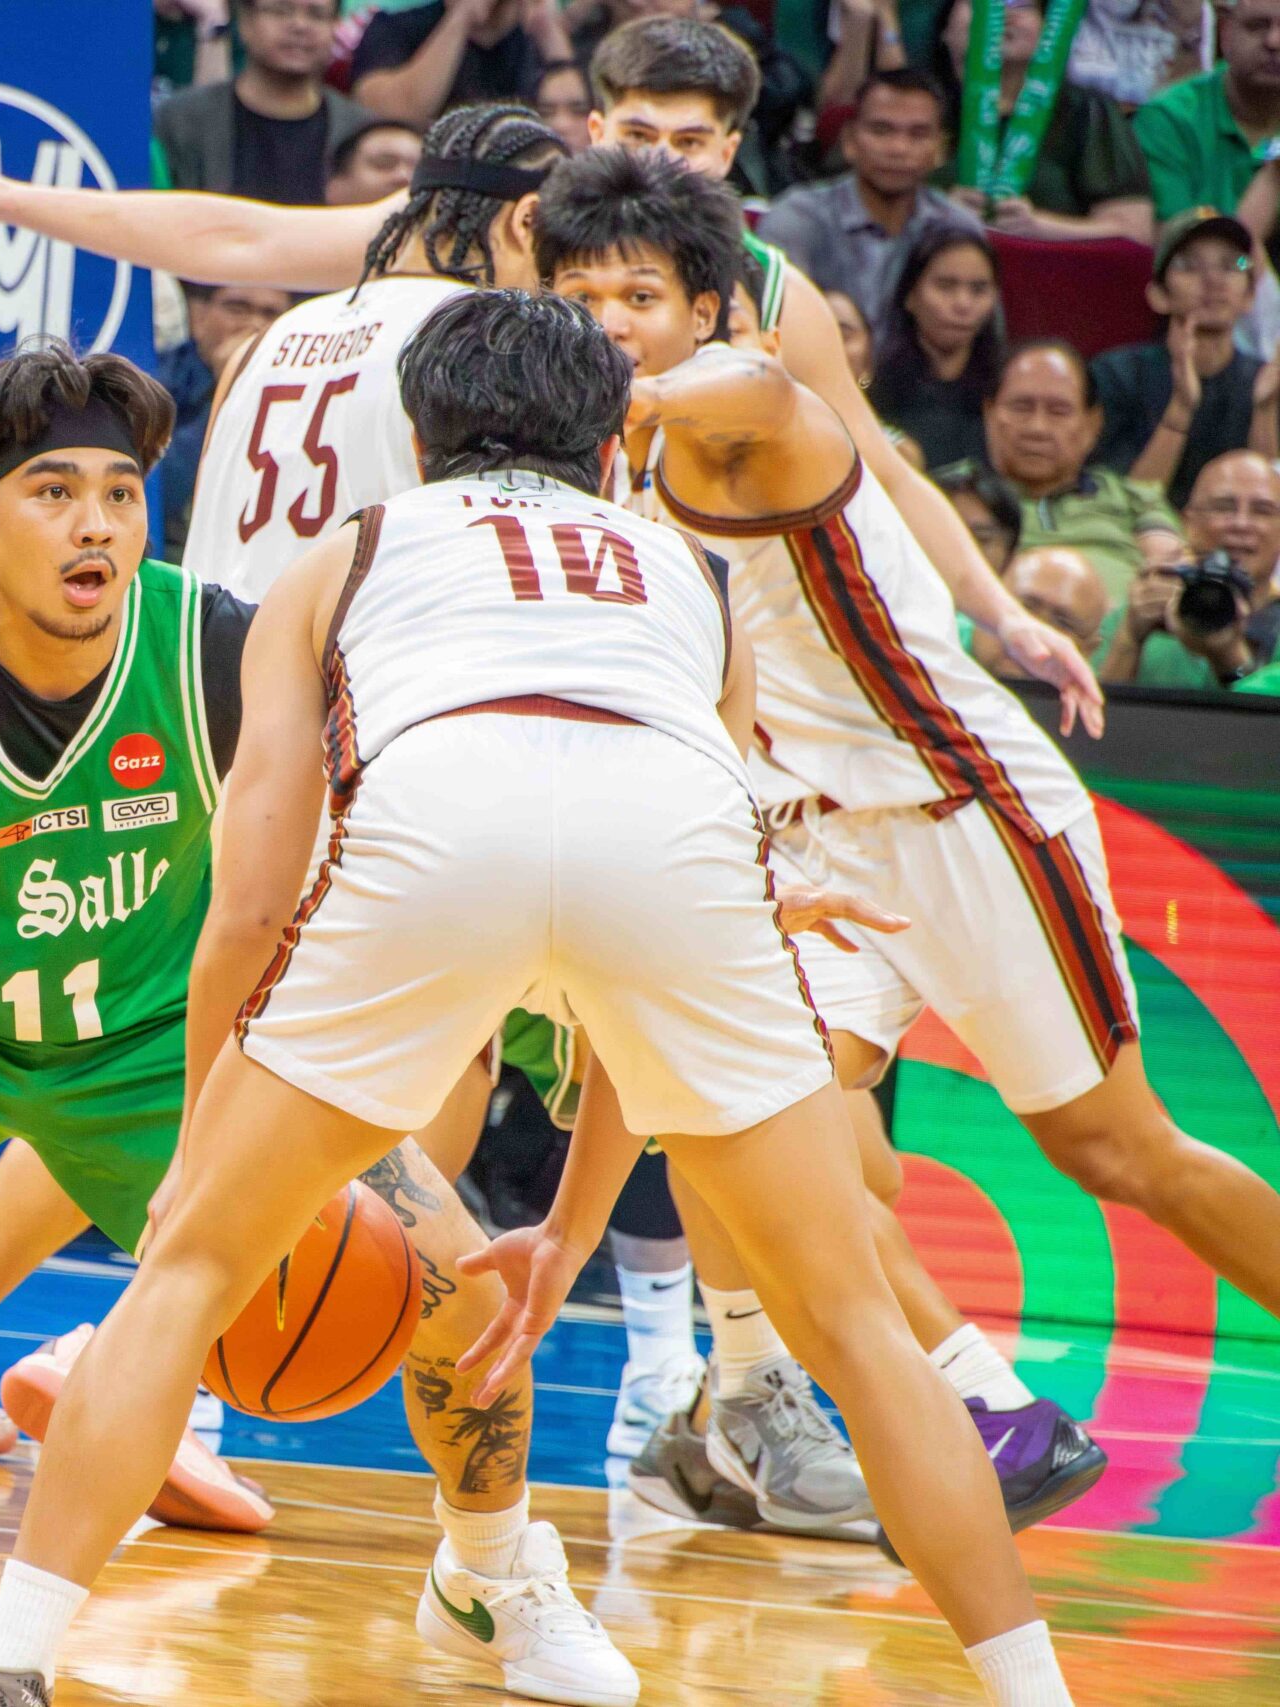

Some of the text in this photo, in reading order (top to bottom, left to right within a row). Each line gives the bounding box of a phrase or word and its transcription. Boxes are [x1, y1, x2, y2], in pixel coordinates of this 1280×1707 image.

[238, 371, 360, 545] 55
[465, 513, 649, 606] 10
[113, 754, 161, 771] Gazz
[32, 808, 87, 833] ICTSI
[117, 800, 164, 817] CWC
[114, 815, 169, 829] INTERIORS
[1, 958, 104, 1043] 11
